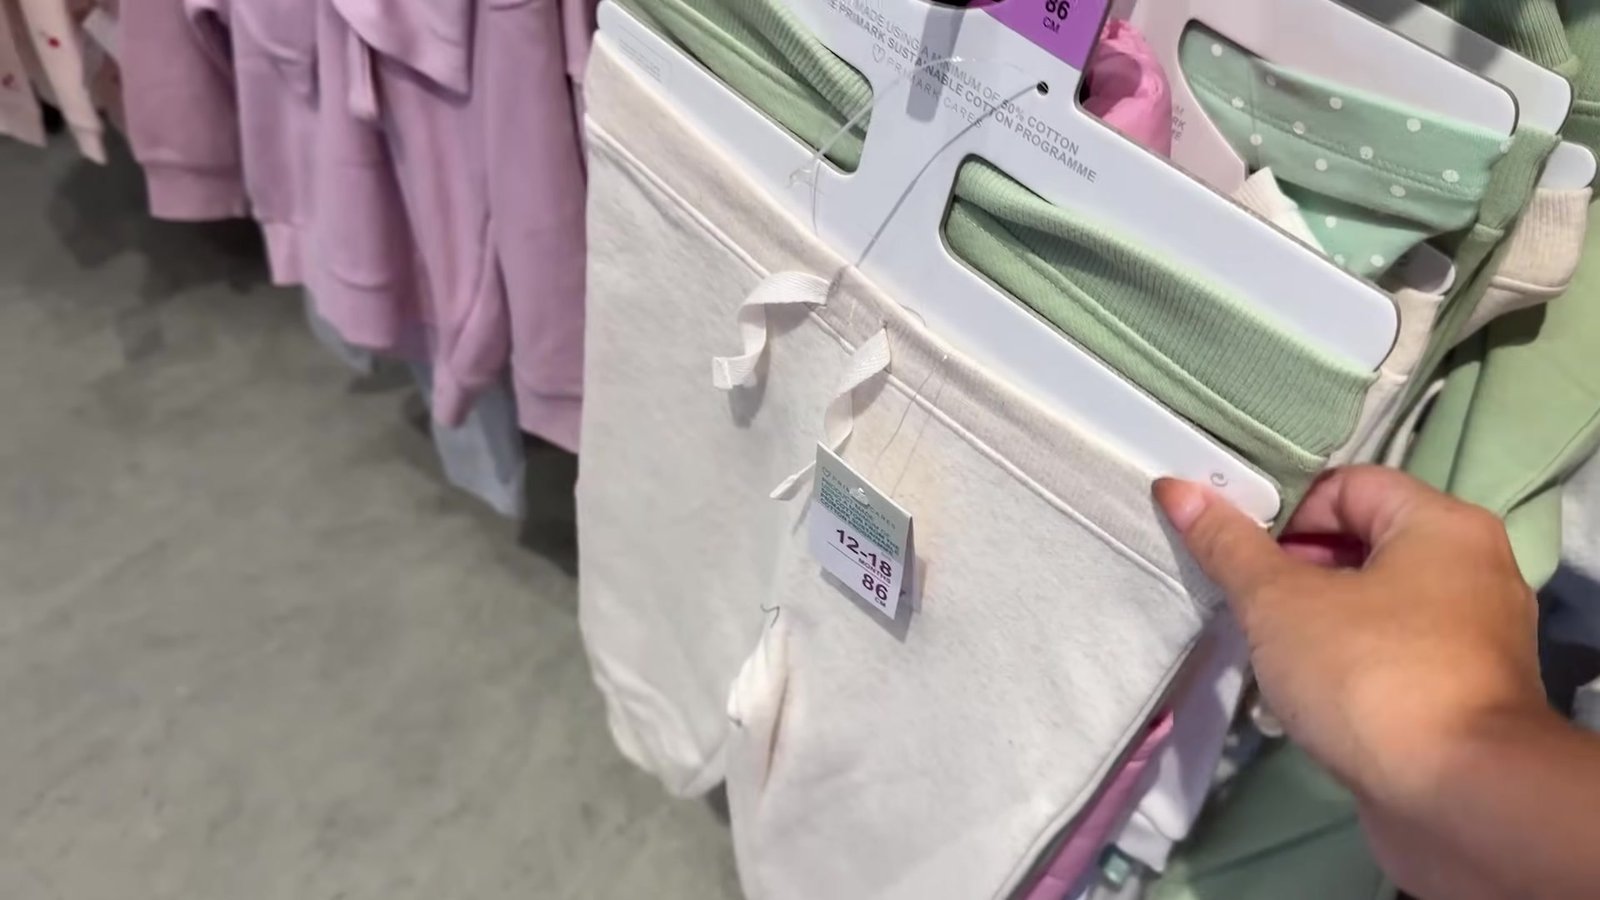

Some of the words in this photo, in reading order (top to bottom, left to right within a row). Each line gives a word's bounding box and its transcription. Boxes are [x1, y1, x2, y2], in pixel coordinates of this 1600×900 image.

[1045, 0, 1070, 20] 86
[1043, 16, 1060, 34] CM
[838, 3, 886, 43] PRIMARK
[965, 90, 1014, 129] COTTON
[1014, 122, 1097, 184] PROGRAMME
[886, 20, 920, 50] USING
[921, 46, 929, 58] A
[983, 86, 1001, 101] OF
[1027, 115, 1080, 156] COTTON
[836, 529, 892, 577] 12-18
[858, 556, 892, 584] MONTHS
[861, 574, 889, 602] 86
[874, 596, 887, 608] CM
